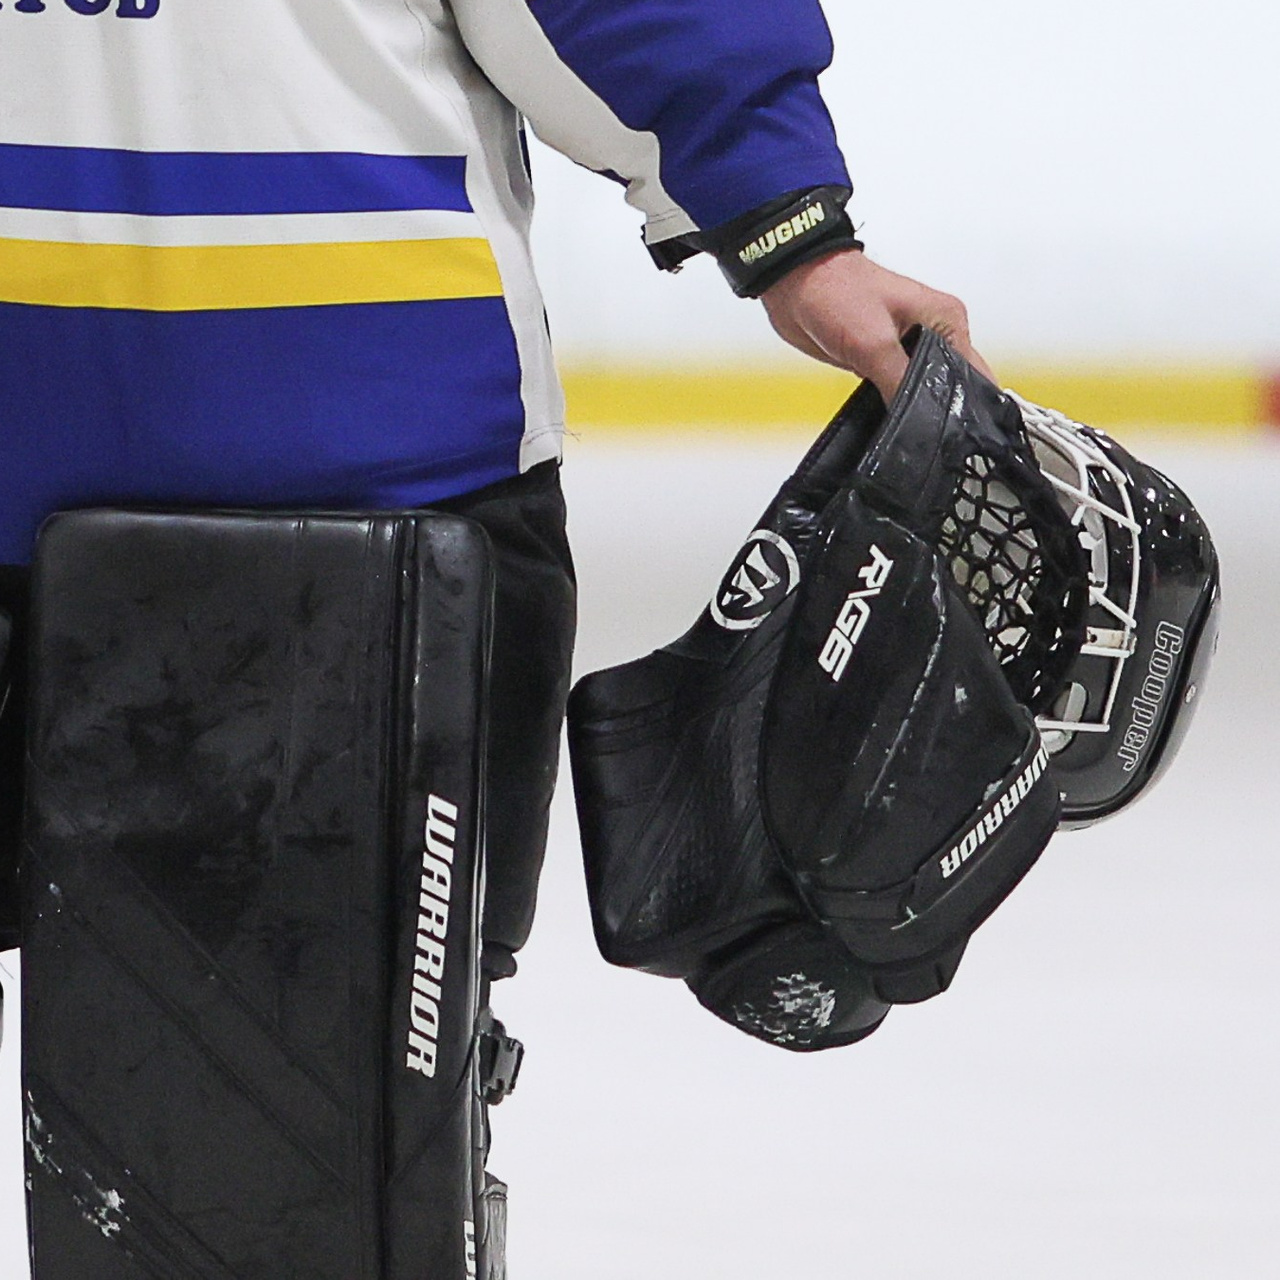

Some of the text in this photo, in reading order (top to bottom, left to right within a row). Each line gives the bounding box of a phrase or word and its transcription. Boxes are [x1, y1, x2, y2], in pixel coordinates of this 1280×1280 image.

[738, 201, 825, 265] VAUGHN
[1117, 620, 1184, 772] Cooper
[406, 793, 458, 1078] WARRIOR
